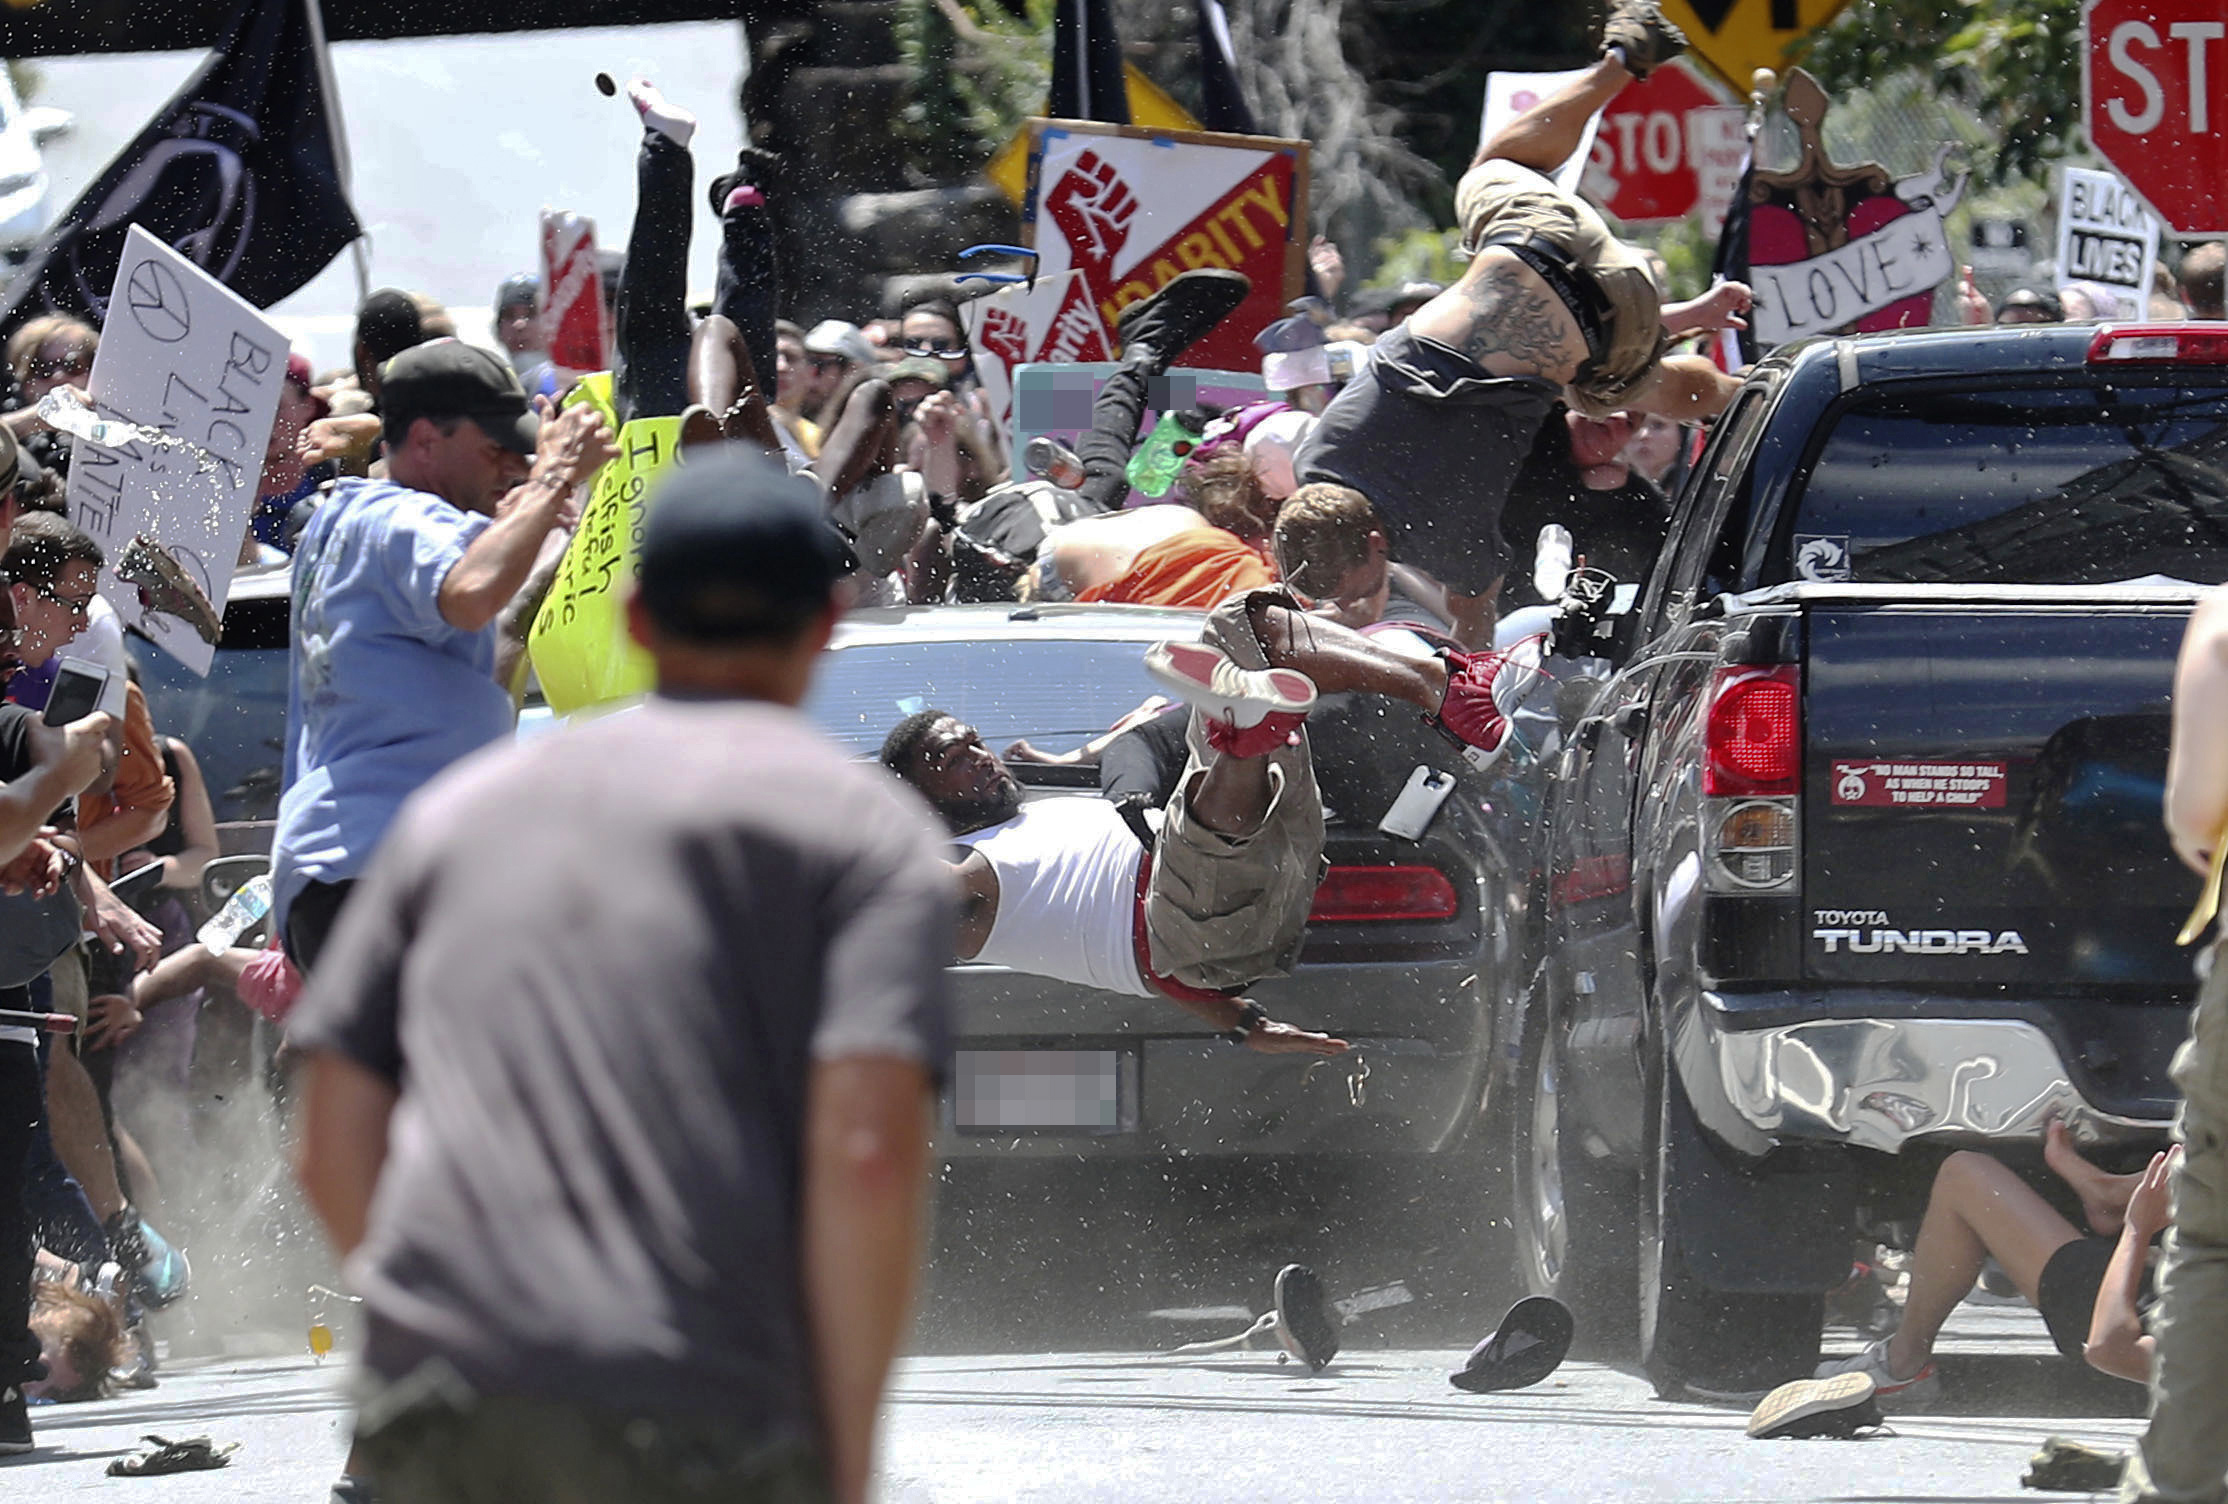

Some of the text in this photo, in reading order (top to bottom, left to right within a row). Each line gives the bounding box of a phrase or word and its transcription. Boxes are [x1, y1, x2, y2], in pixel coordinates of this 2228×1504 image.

[2107, 20, 2225, 134] ST
[1590, 111, 1699, 174] STO
[1768, 233, 1914, 328] LOVE
[2069, 234, 2142, 283] LIVES
[1048, 298, 1098, 363] arity
[195, 331, 271, 490] BLACK
[78, 402, 143, 537] MATTE
[1884, 778, 1991, 791] AS WHEN HE STOOPS
[1892, 764, 1918, 777] MAN
[1918, 765, 1959, 778] STANDS
[1960, 766, 1975, 777] SO
[1892, 791, 1907, 802] TO
[1907, 791, 1935, 802] HELP
[1935, 792, 1945, 803] A
[1813, 929, 2029, 955] TUNDRA
[1814, 910, 1889, 926] TOYOTA
